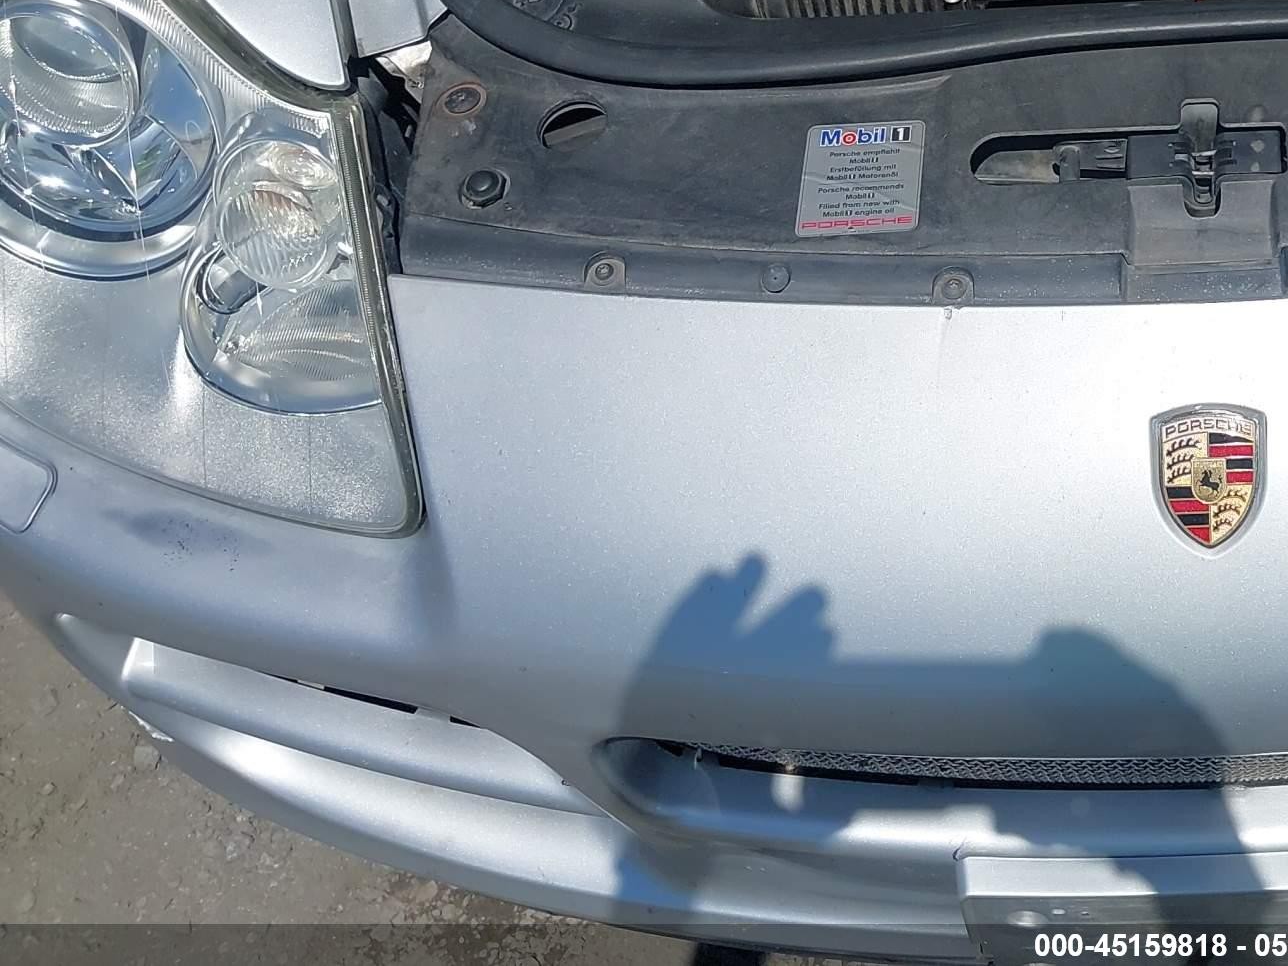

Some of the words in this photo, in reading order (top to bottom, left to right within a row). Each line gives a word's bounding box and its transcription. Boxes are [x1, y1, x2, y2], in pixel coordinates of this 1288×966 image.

[820, 127, 888, 146] Mobil
[818, 185, 850, 194] Porsche
[845, 193, 868, 201] Mobil
[823, 210, 845, 218] Mobil
[801, 217, 913, 229] PORSCHE
[1164, 418, 1252, 439] PORSCHE
